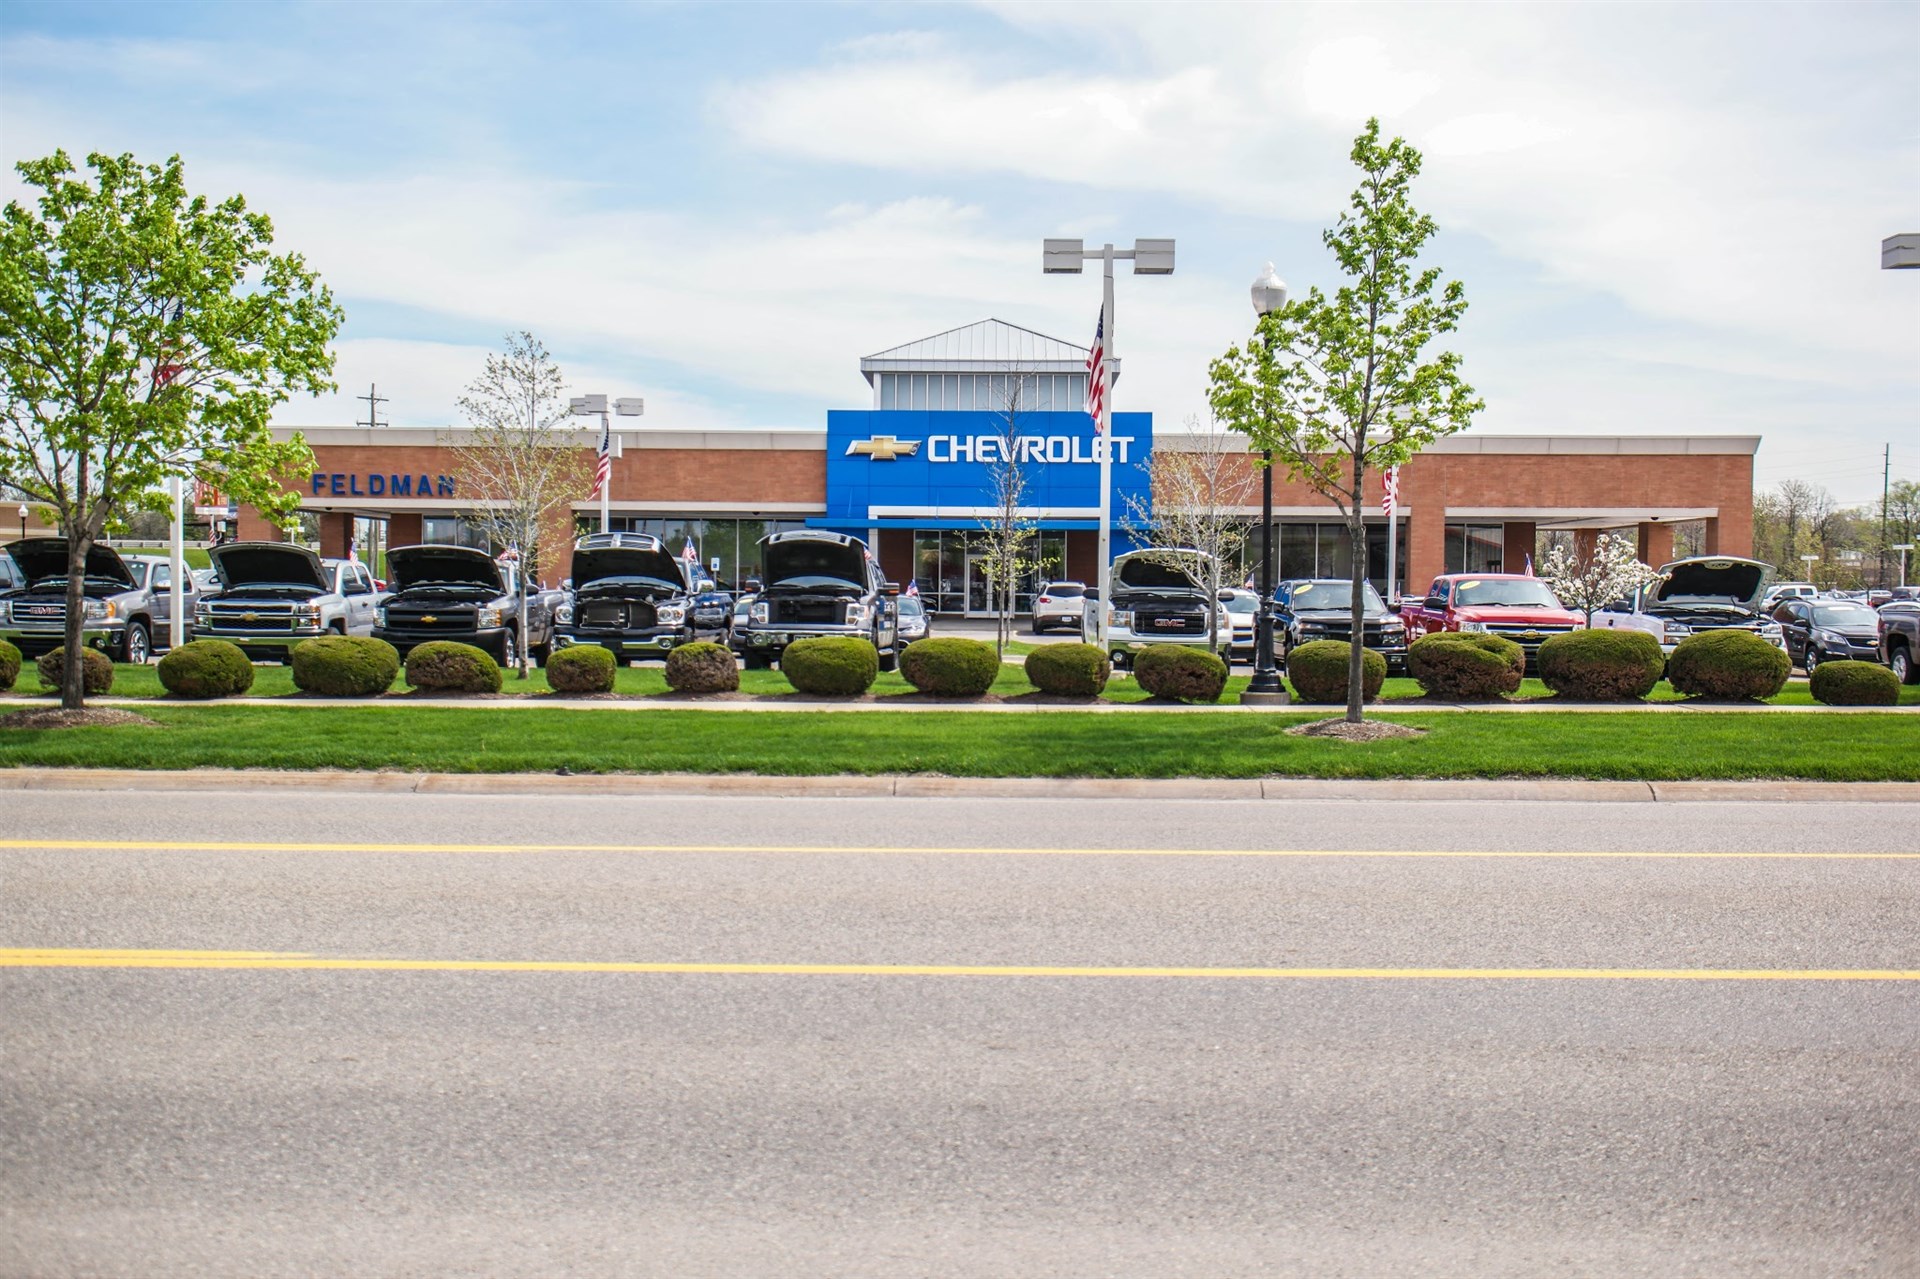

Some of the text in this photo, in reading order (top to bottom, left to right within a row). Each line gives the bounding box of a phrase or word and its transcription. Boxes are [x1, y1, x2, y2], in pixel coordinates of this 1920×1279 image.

[927, 434, 1135, 463] CHEVROLET
[312, 473, 455, 496] FELDMAN
[1154, 618, 1186, 628] GMC
